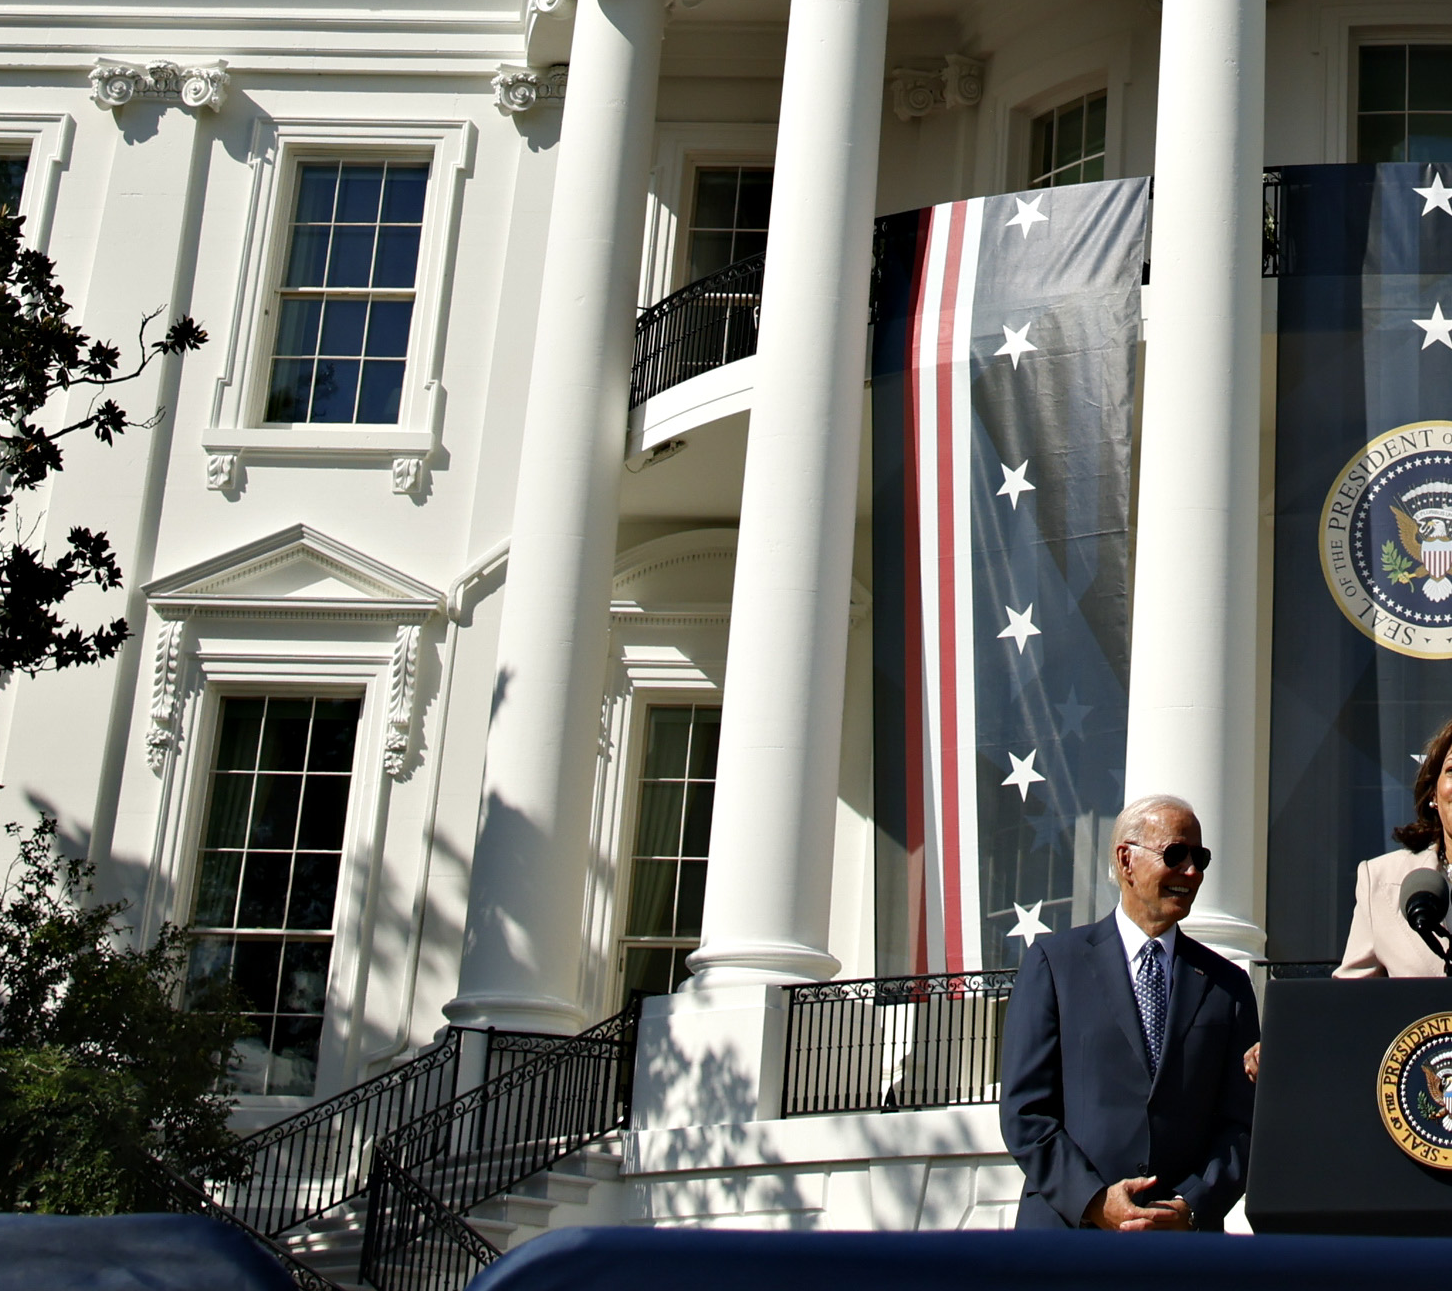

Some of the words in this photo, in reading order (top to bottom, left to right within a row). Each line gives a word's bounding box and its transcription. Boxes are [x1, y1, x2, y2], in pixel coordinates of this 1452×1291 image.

[1328, 429, 1434, 531] PRESIDENT
[1331, 539, 1347, 574] THE
[1339, 578, 1357, 598] OF
[1358, 598, 1416, 645] SEAL
[1383, 1018, 1450, 1086] PRESIDENT
[1384, 1091, 1396, 1114] THE
[1390, 1116, 1403, 1130] OF
[1402, 1128, 1440, 1161] SEAL
